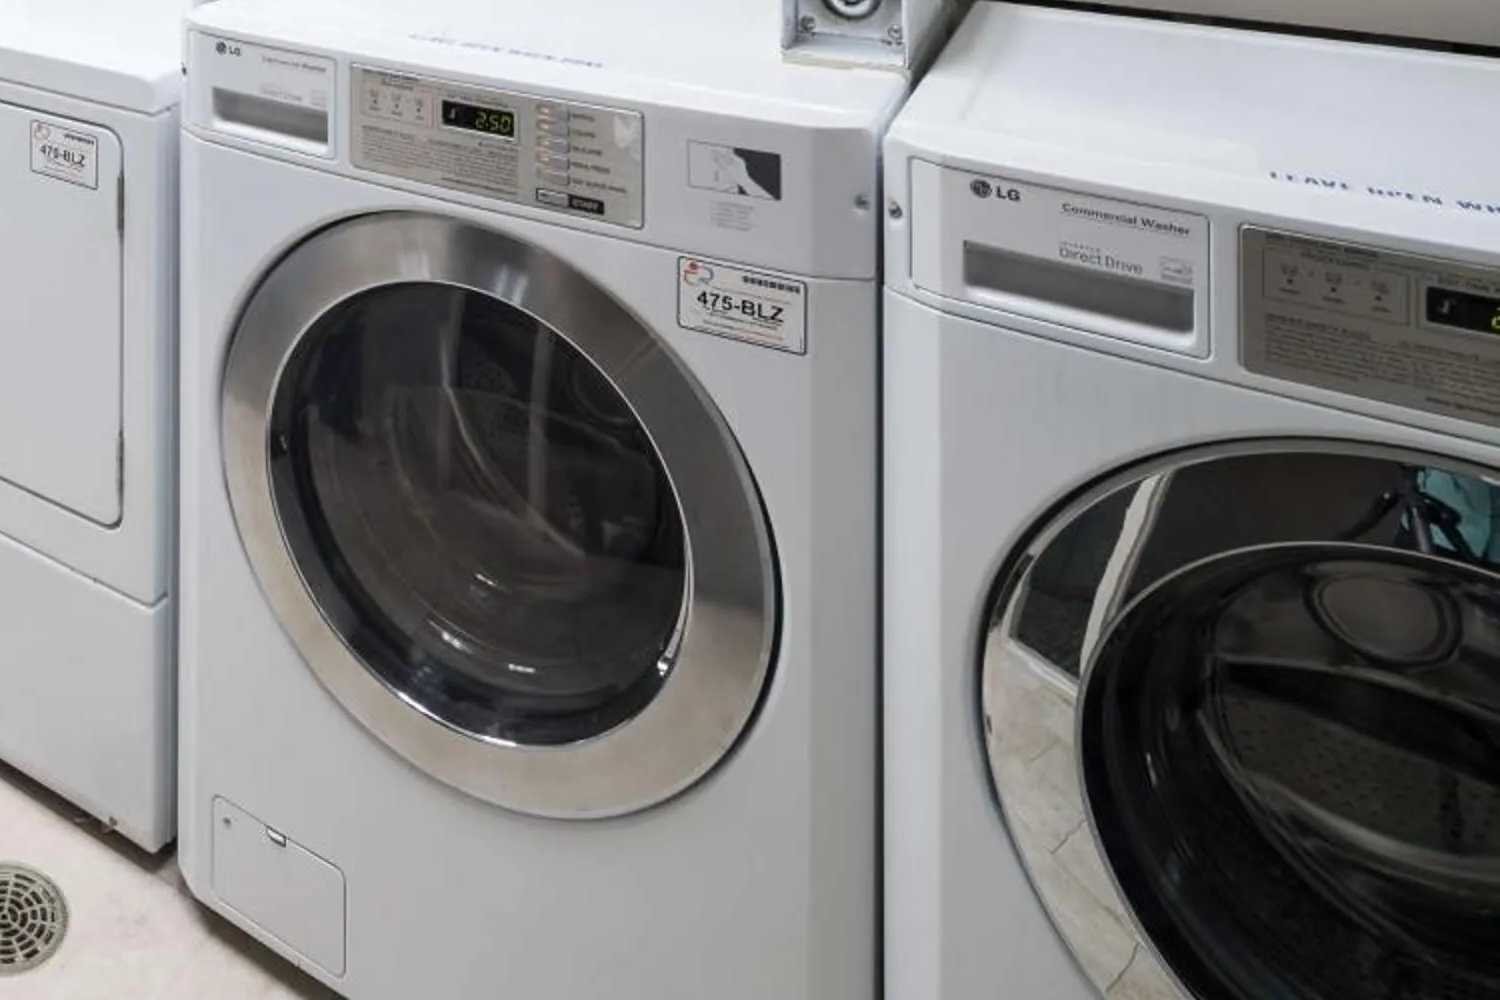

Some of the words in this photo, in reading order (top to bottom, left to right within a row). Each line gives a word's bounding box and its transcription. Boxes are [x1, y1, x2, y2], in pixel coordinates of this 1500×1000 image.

[475, 111, 512, 133] 2.50
[996, 186, 1021, 202] LG
[1061, 203, 1138, 226] Commercial
[1140, 217, 1190, 235] Washer
[1059, 247, 1102, 266] Direct
[1104, 255, 1143, 275] Drive
[697, 291, 785, 324] 475-BLZ
